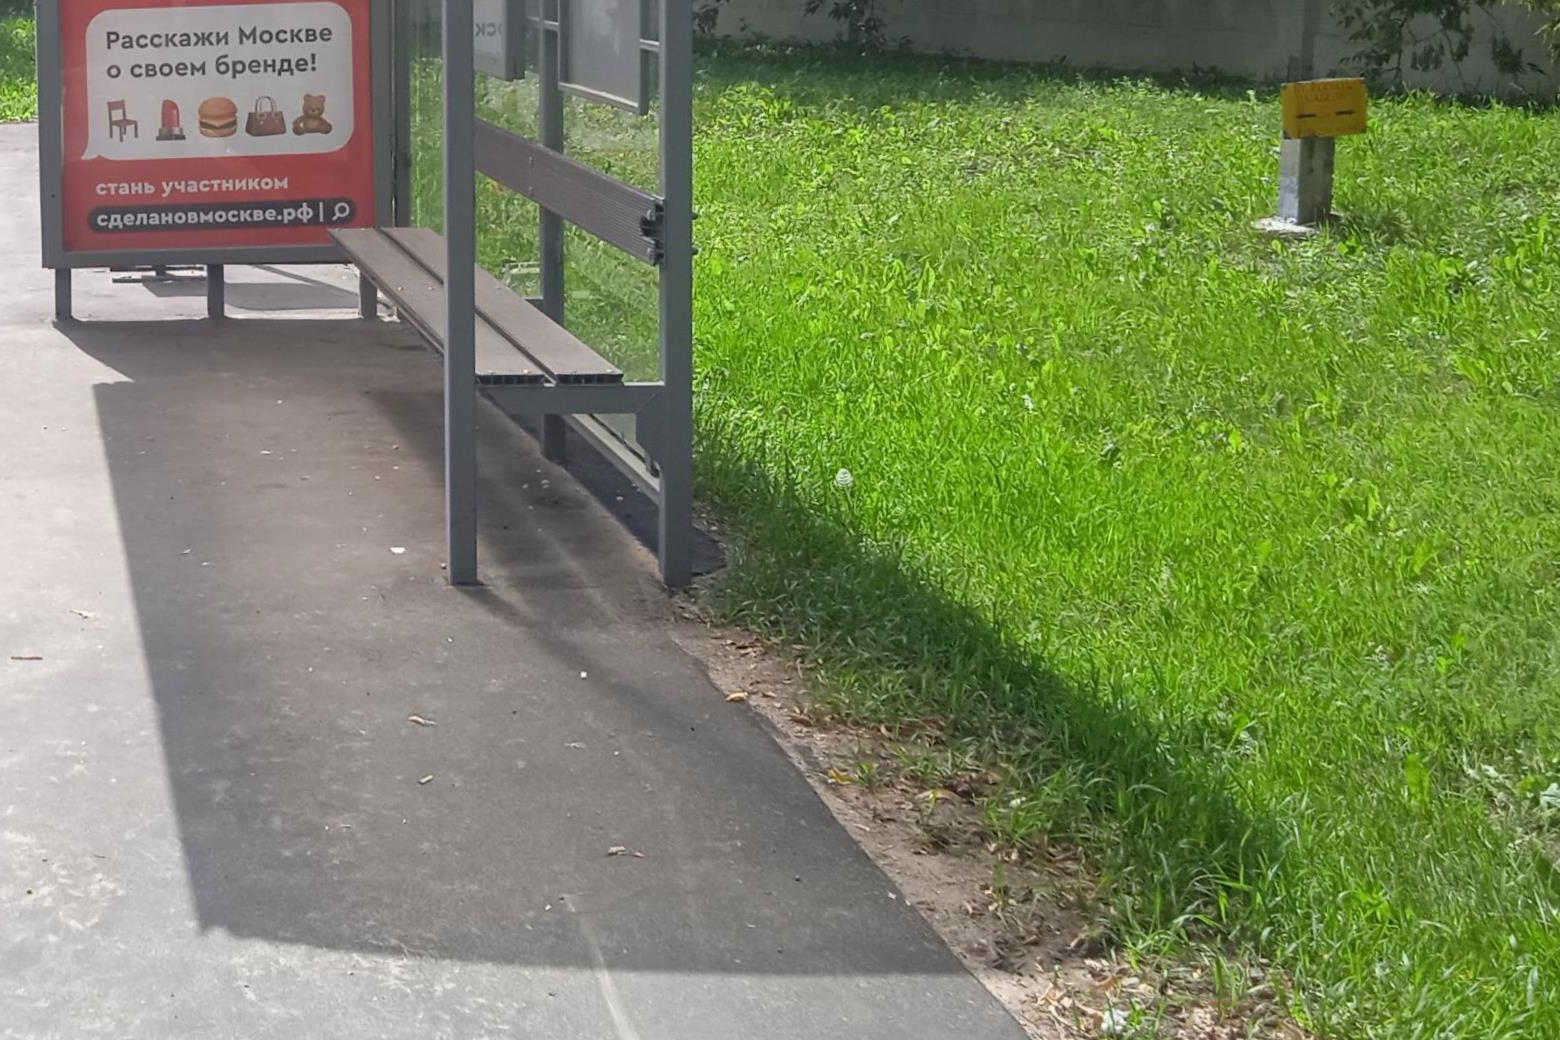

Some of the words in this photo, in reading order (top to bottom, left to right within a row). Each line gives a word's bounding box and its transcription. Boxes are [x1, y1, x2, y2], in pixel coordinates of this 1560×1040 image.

[105, 29, 230, 51] Расскажи
[238, 24, 334, 47] Москве
[106, 64, 122, 79] о
[129, 61, 207, 79] своем
[215, 53, 318, 79] бренде!
[95, 179, 155, 196] стань
[161, 176, 289, 198] участником
[95, 203, 314, 229] сделановмоскве.рф
